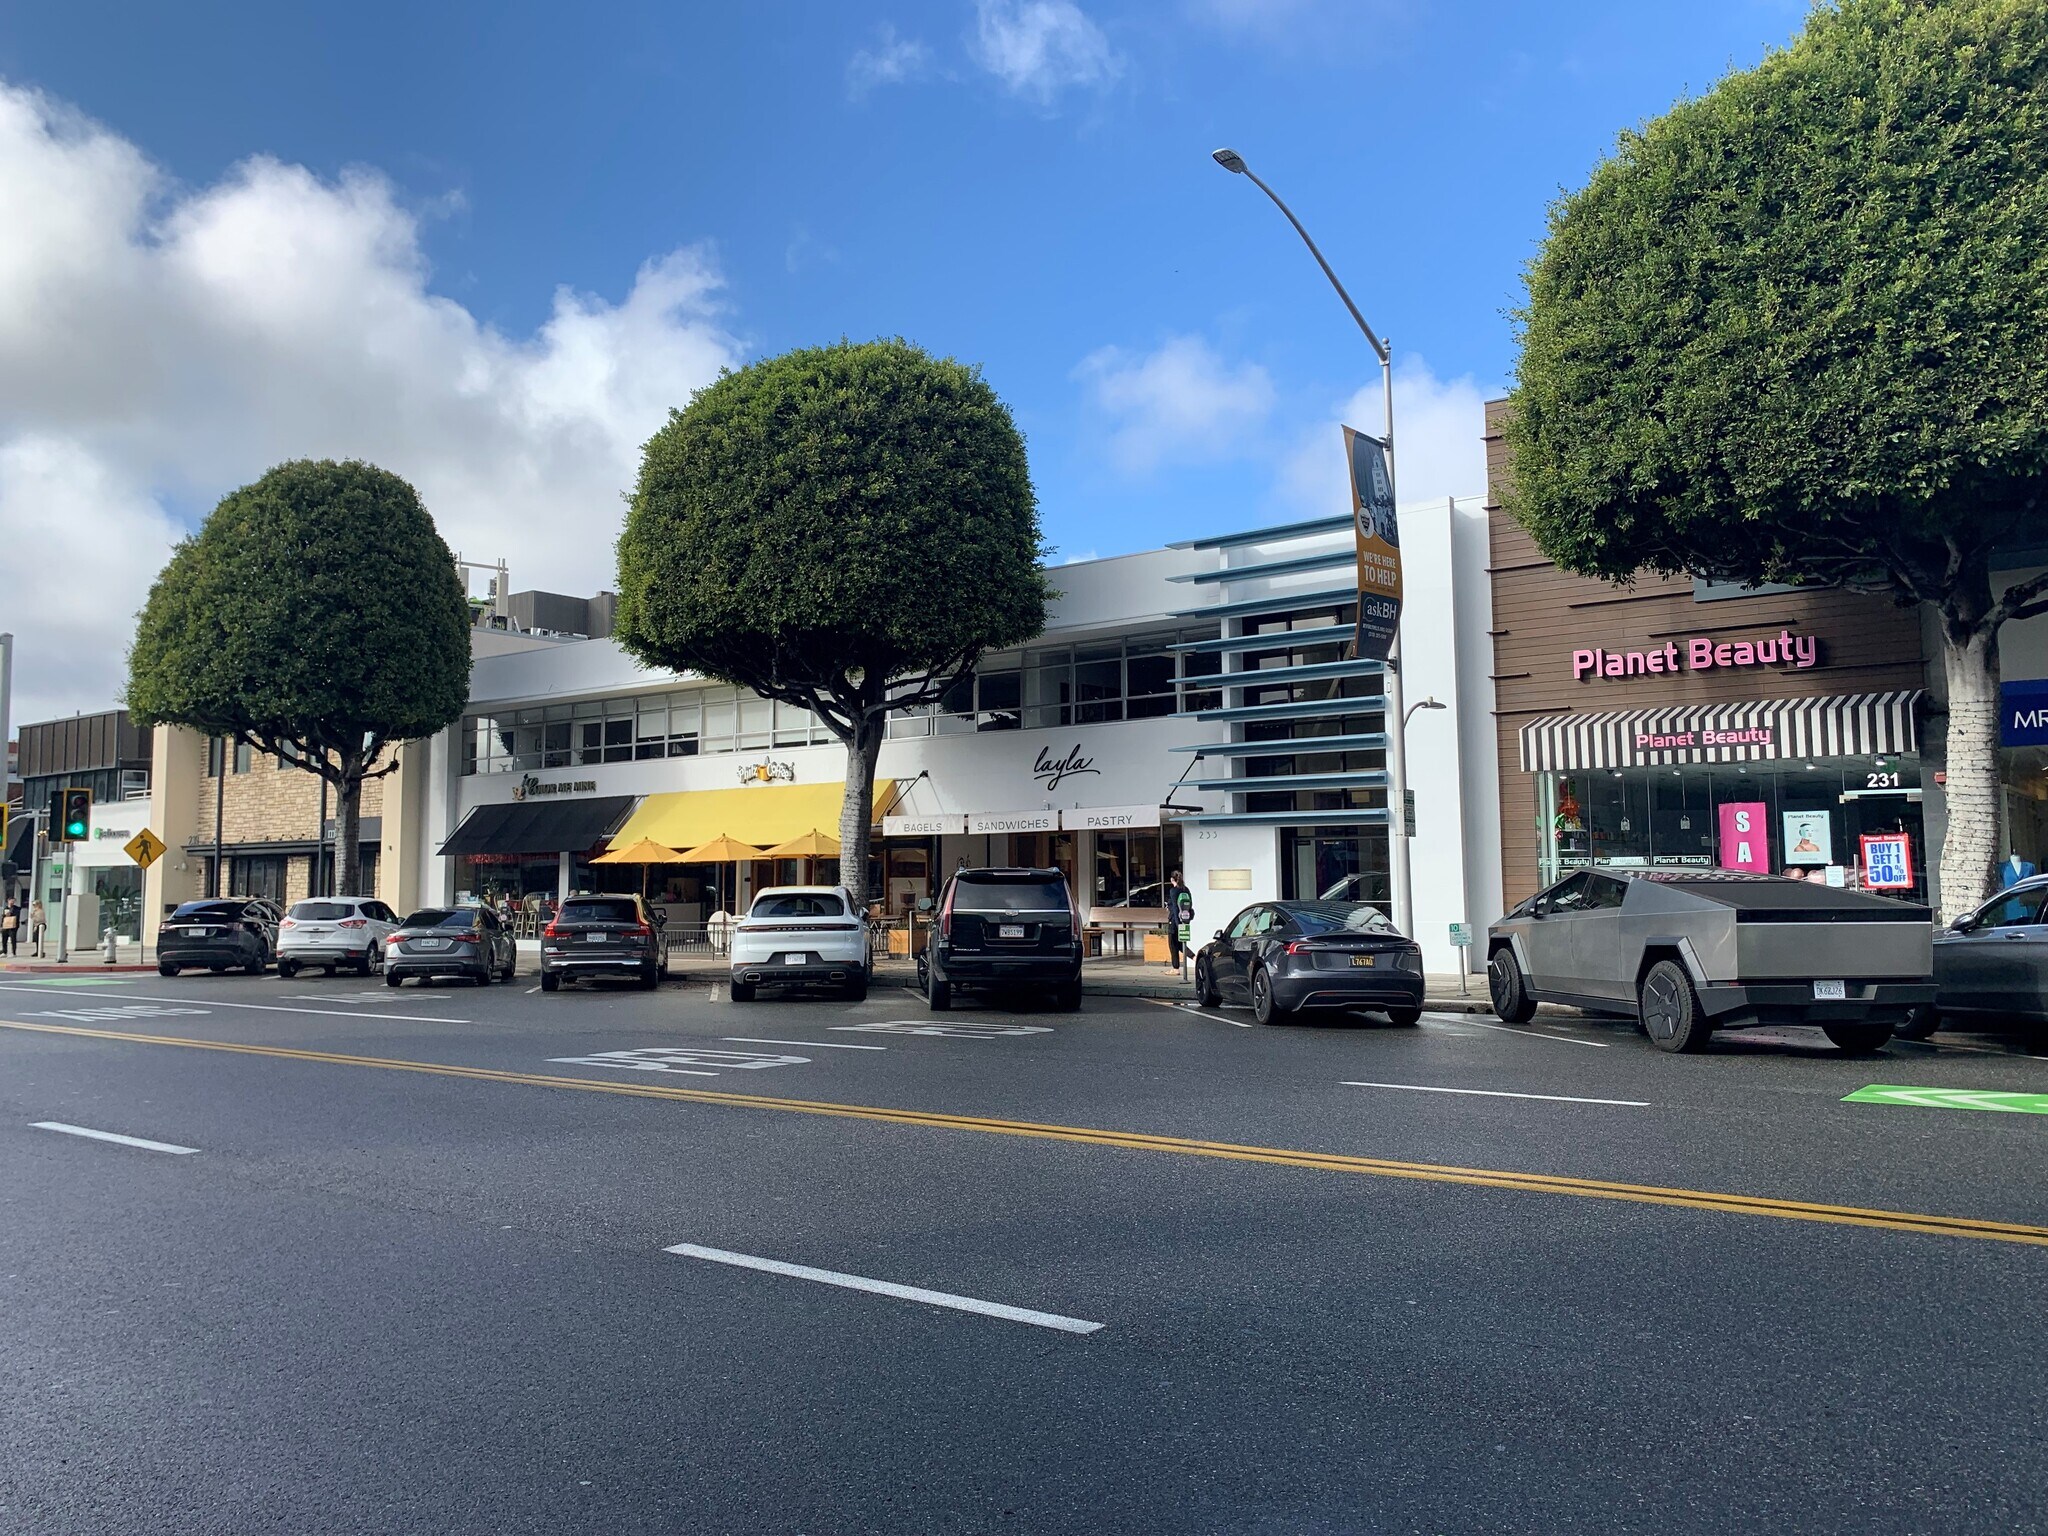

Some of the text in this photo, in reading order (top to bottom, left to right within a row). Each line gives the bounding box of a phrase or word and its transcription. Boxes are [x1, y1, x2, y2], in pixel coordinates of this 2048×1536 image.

[1363, 551, 1396, 569] WE'RE HERE
[1364, 565, 1397, 587] TO HELP
[1366, 601, 1397, 620] askBH
[1572, 630, 1816, 680] Planet Beauty
[1636, 727, 1771, 749] Planet Beauty
[1034, 744, 1100, 791] layla
[1867, 772, 1899, 788] 231
[903, 822, 943, 833] BAGELS
[977, 818, 1049, 832] SANDWICHES
[1087, 815, 1133, 827] PASTRY
[1870, 843, 1900, 854] BUY 1
[1564, 859, 1590, 867] Beauty
[1681, 856, 1709, 865] Beauty
[1872, 854, 1900, 865] GET 1
[1451, 924, 1459, 932] 10
